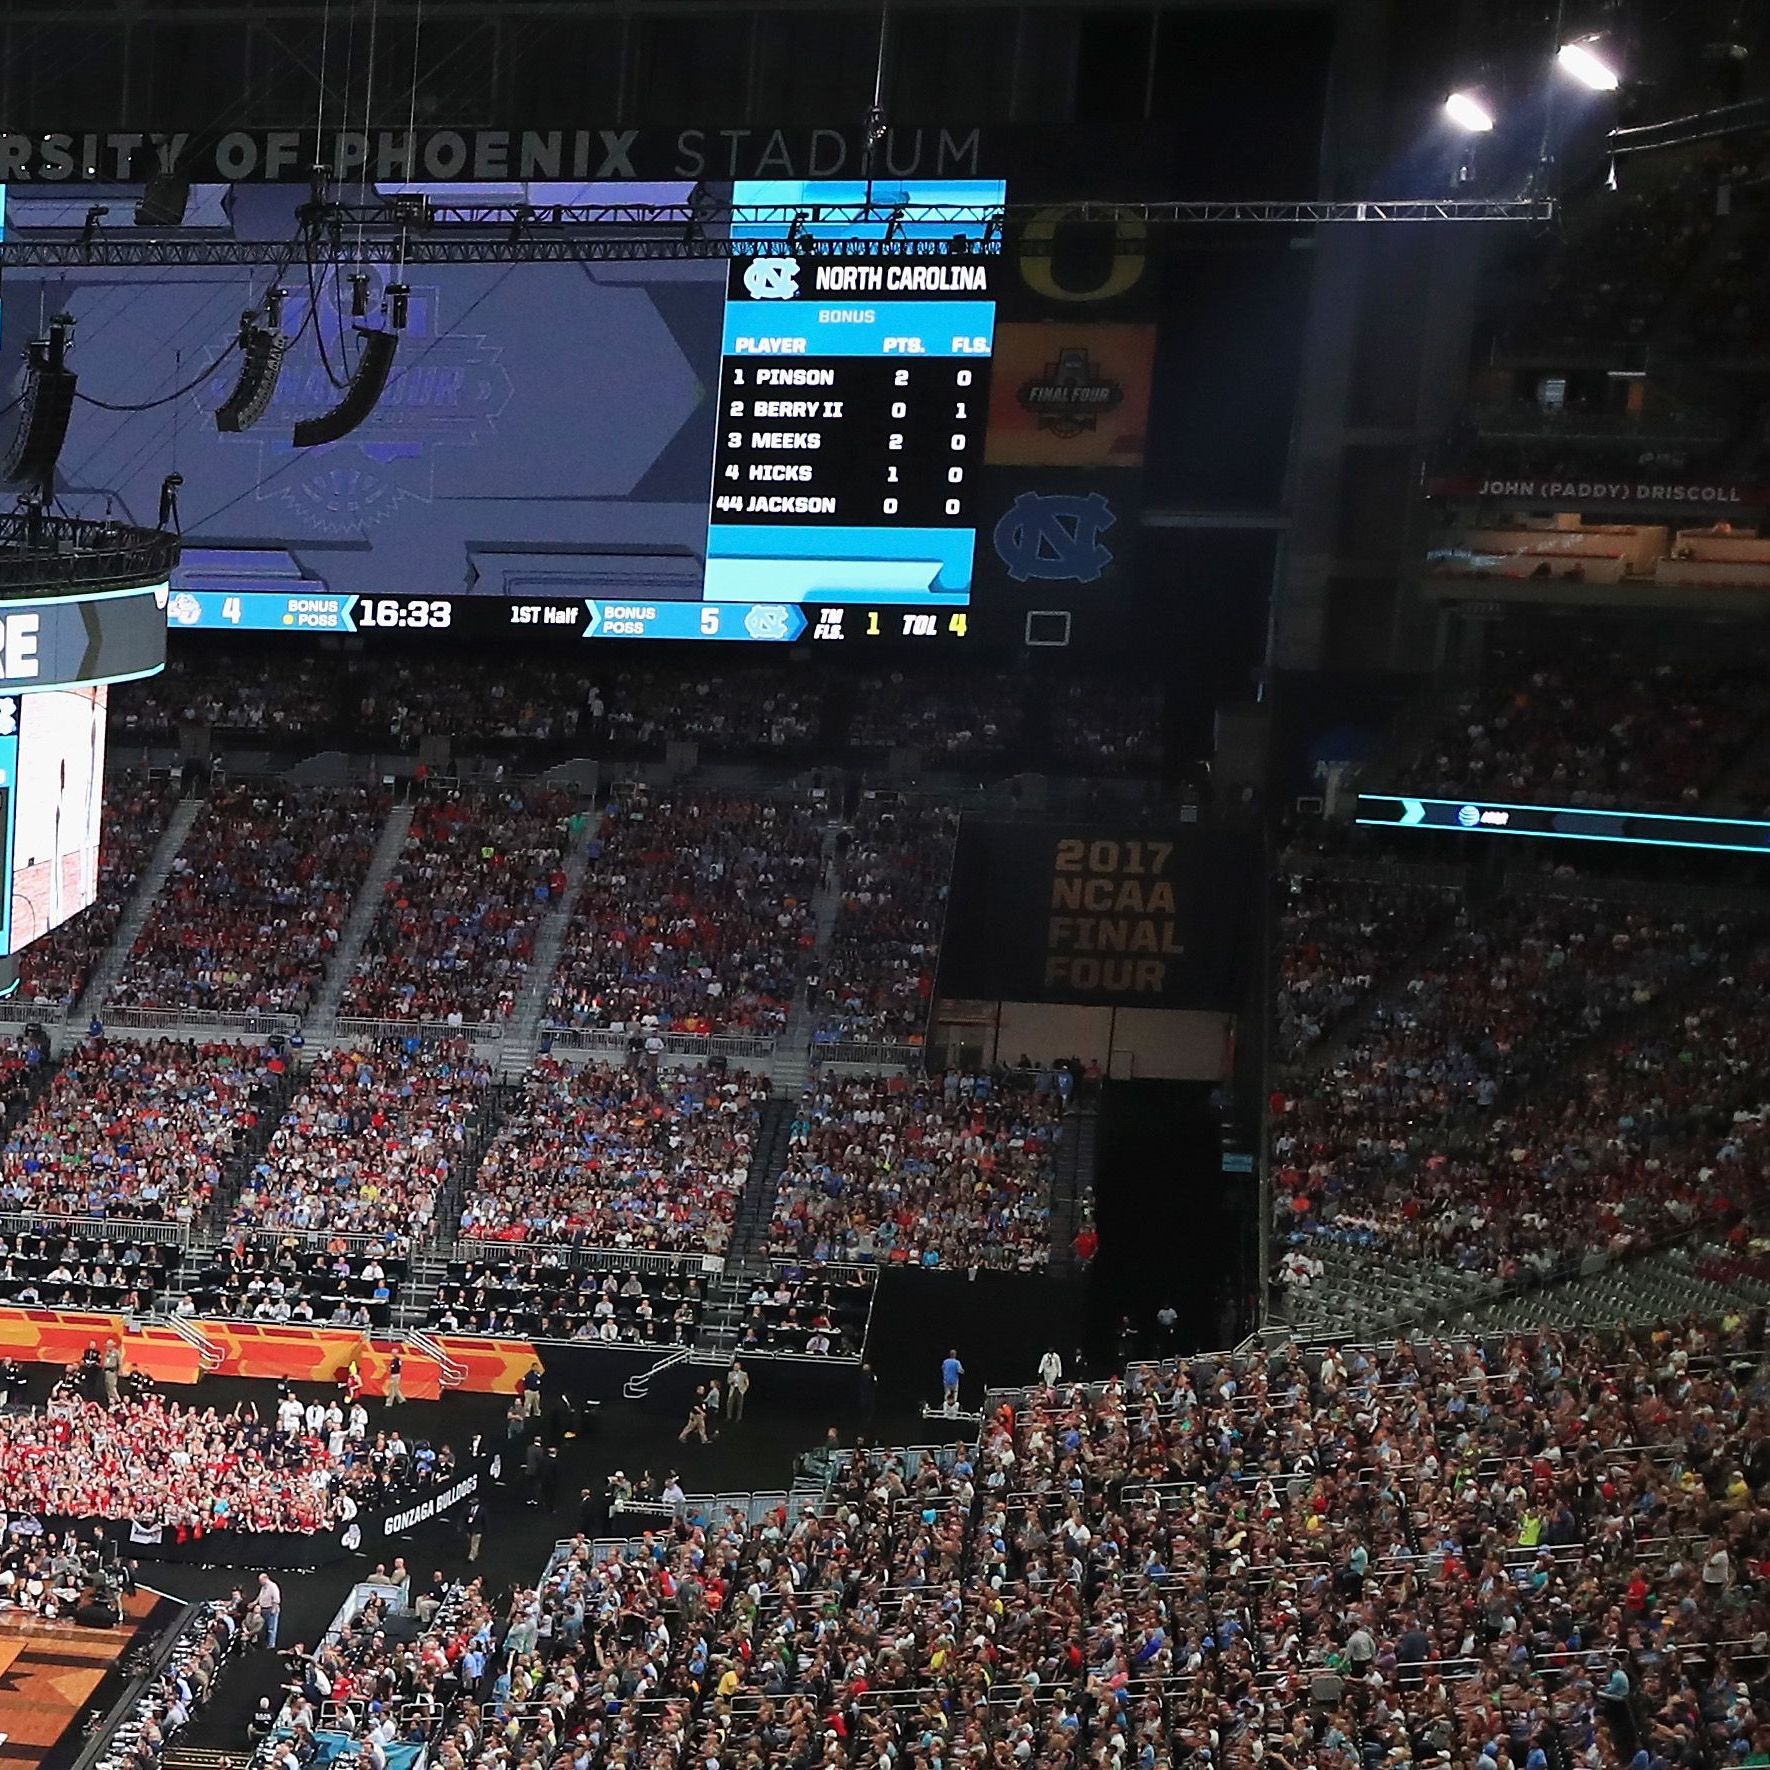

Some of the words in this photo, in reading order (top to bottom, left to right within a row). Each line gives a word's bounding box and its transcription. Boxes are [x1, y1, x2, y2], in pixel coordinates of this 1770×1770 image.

[215, 131, 300, 179] OF
[334, 129, 640, 179] PHOENIX
[674, 128, 981, 178] STADIUM
[816, 266, 882, 290] NORTH
[887, 266, 987, 290] CAROLINA
[818, 310, 875, 323] BONUS
[735, 337, 807, 353] PLAYER
[883, 338, 925, 353] PTS.
[952, 337, 991, 353] FLS.
[733, 369, 744, 385] 1
[756, 369, 834, 386] PINSON
[894, 370, 908, 386] 2
[957, 370, 972, 386] 0
[1029, 387, 1069, 402] FINAL
[1071, 387, 1110, 402] FOUR
[730, 401, 744, 417] 2
[754, 401, 819, 418] BERRY
[822, 402, 843, 418] II
[891, 402, 906, 418] 0
[955, 402, 966, 418] 1
[728, 432, 742, 448] 3
[751, 432, 821, 449] MEEKS
[889, 434, 903, 450] 2
[951, 434, 966, 450] 0
[725, 464, 739, 480] 4
[749, 465, 812, 482] HICKS
[887, 466, 898, 482] 1
[948, 467, 962, 483] 0
[1479, 480, 1534, 496] JOHN
[1540, 483, 1630, 500] (PADDY)
[1636, 484, 1741, 502] DRISCOLL
[716, 496, 743, 512] 44
[746, 496, 836, 513] JACKSON
[883, 498, 898, 514] 0
[945, 498, 960, 514] 0
[221, 598, 241, 624] 4
[287, 599, 338, 613] BONUS
[359, 600, 451, 628] 16:33
[510, 605, 542, 623] 1ST
[544, 606, 578, 625] Half
[603, 606, 656, 620] BONUS
[297, 614, 338, 627] POSS
[700, 607, 720, 634] 5
[820, 608, 844, 624] TM
[865, 612, 880, 635] 1
[902, 613, 938, 636] TOL
[947, 614, 967, 637] 4
[603, 621, 644, 634] POSS
[813, 624, 844, 640] FLS.
[1055, 839, 1174, 874] 2017
[1051, 878, 1176, 914] NCAA
[1048, 916, 1184, 953] FINAL
[1044, 956, 1166, 992] FOUR
[384, 1500, 434, 1536] GONZAGA
